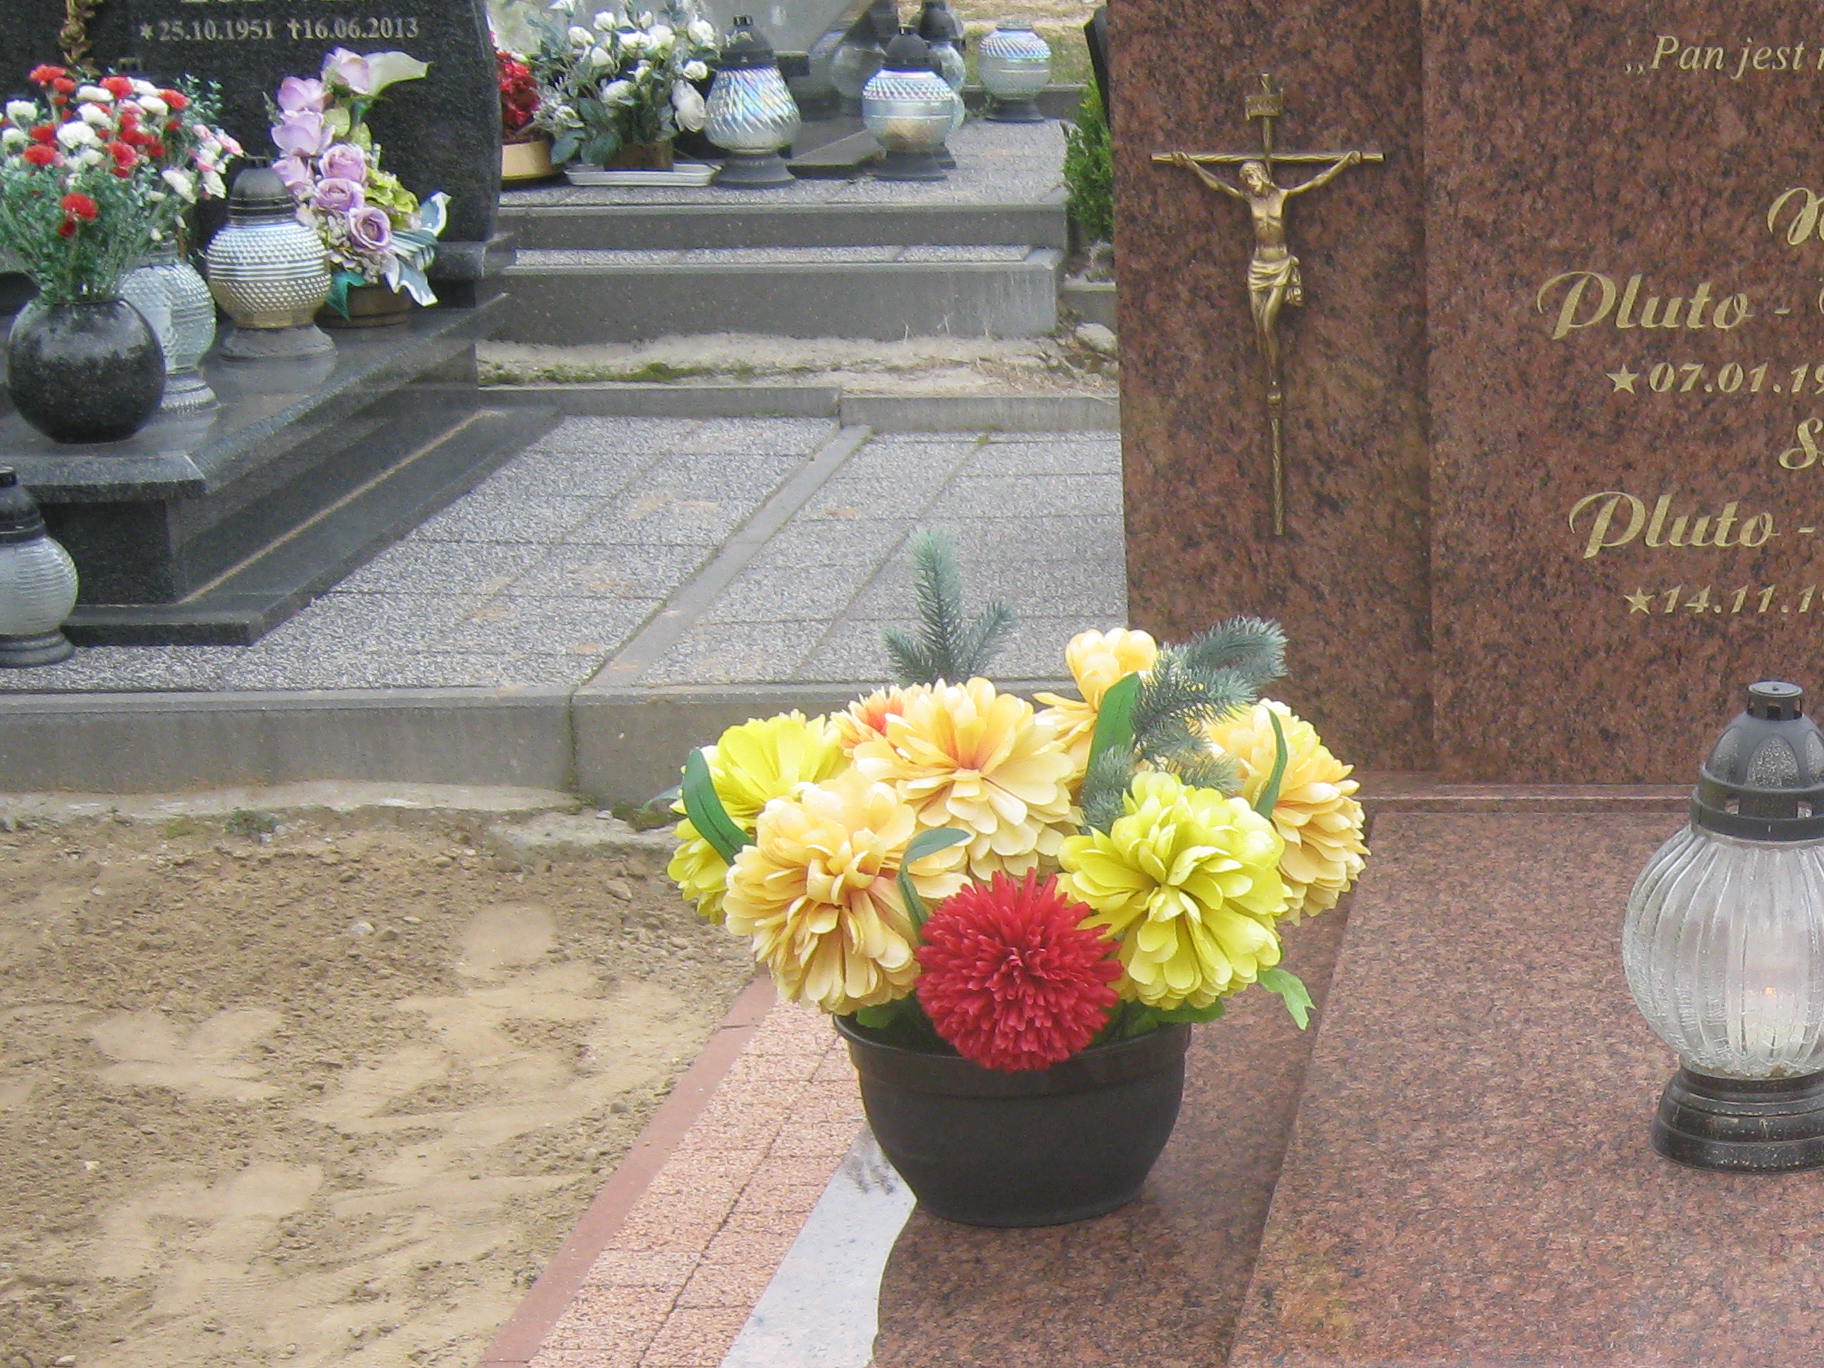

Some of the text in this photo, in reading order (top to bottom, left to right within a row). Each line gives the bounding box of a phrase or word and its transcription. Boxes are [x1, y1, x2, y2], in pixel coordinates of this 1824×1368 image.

[159, 17, 419, 41] 25.10.1951 16.06.2013
[1733, 37, 1805, 78] jest
[1537, 271, 1753, 341] Pluto
[1569, 490, 1780, 560] Pluto
